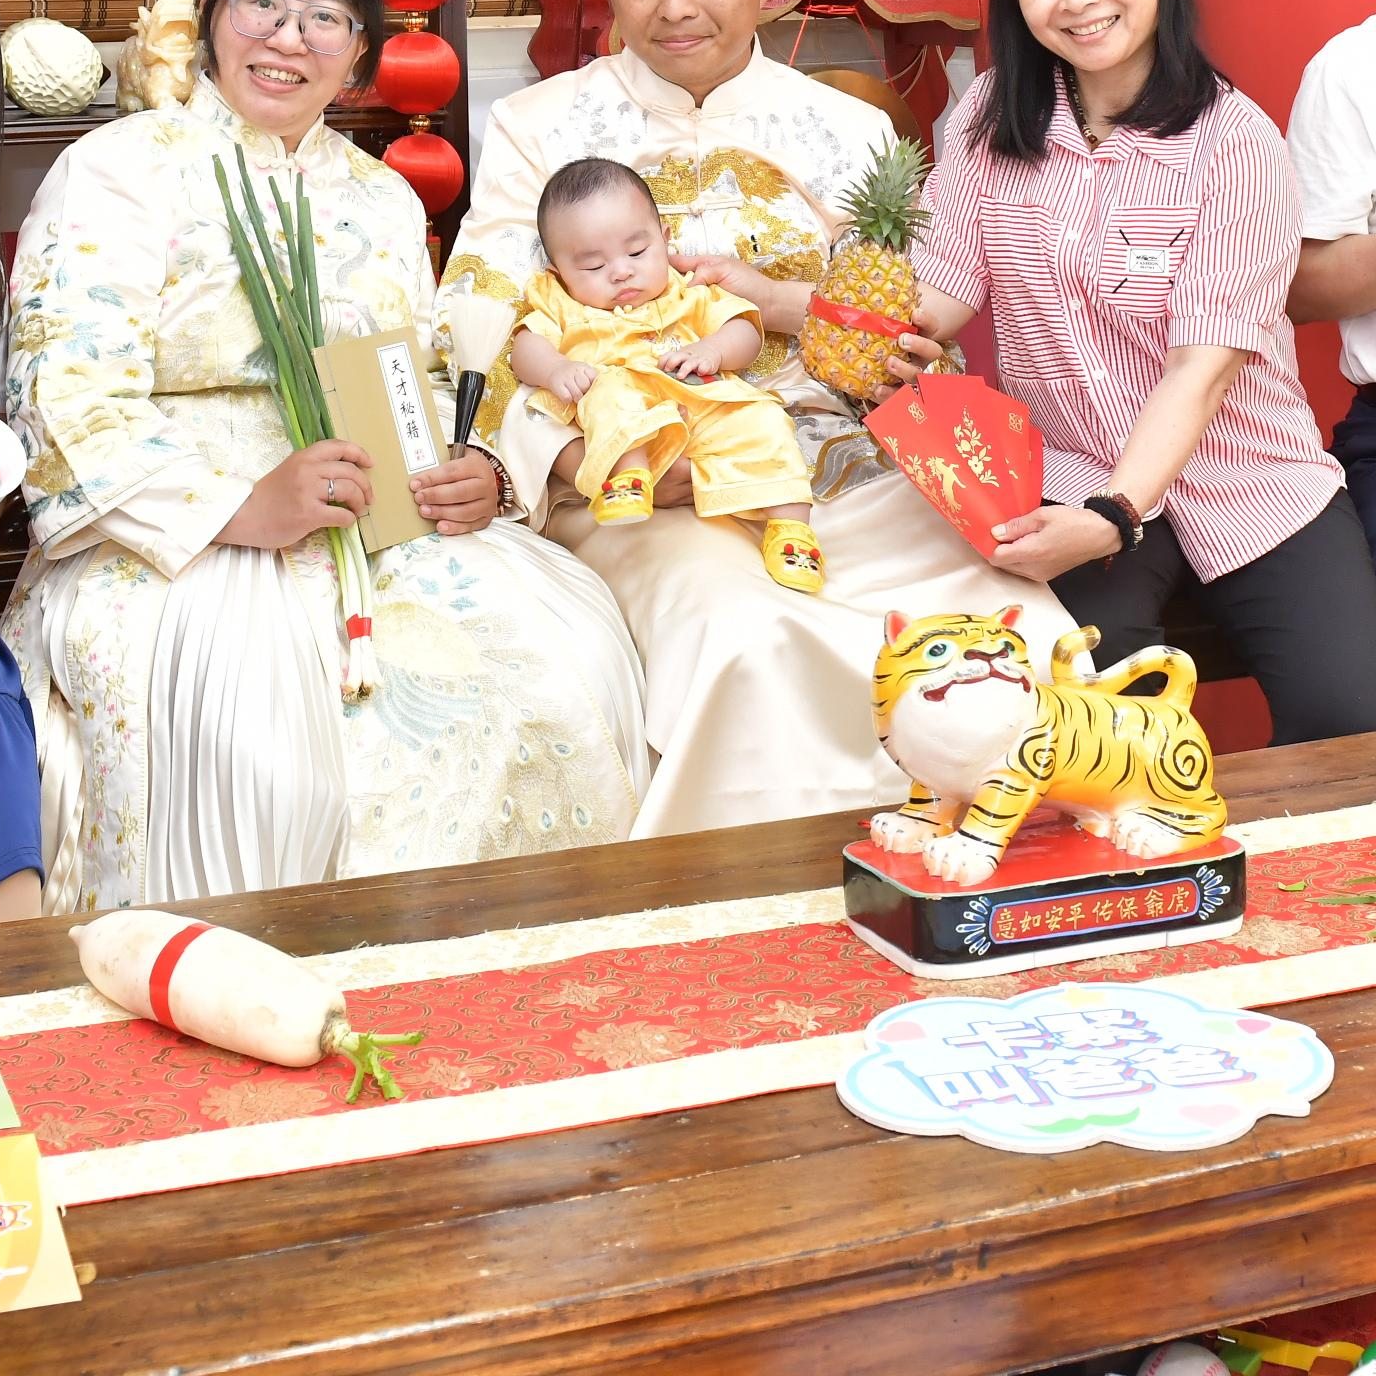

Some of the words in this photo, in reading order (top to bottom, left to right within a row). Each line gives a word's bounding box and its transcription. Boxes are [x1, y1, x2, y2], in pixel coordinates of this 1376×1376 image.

[391, 359, 420, 439] 天才秘籍
[922, 1044, 1257, 1110] 叫爸爸
